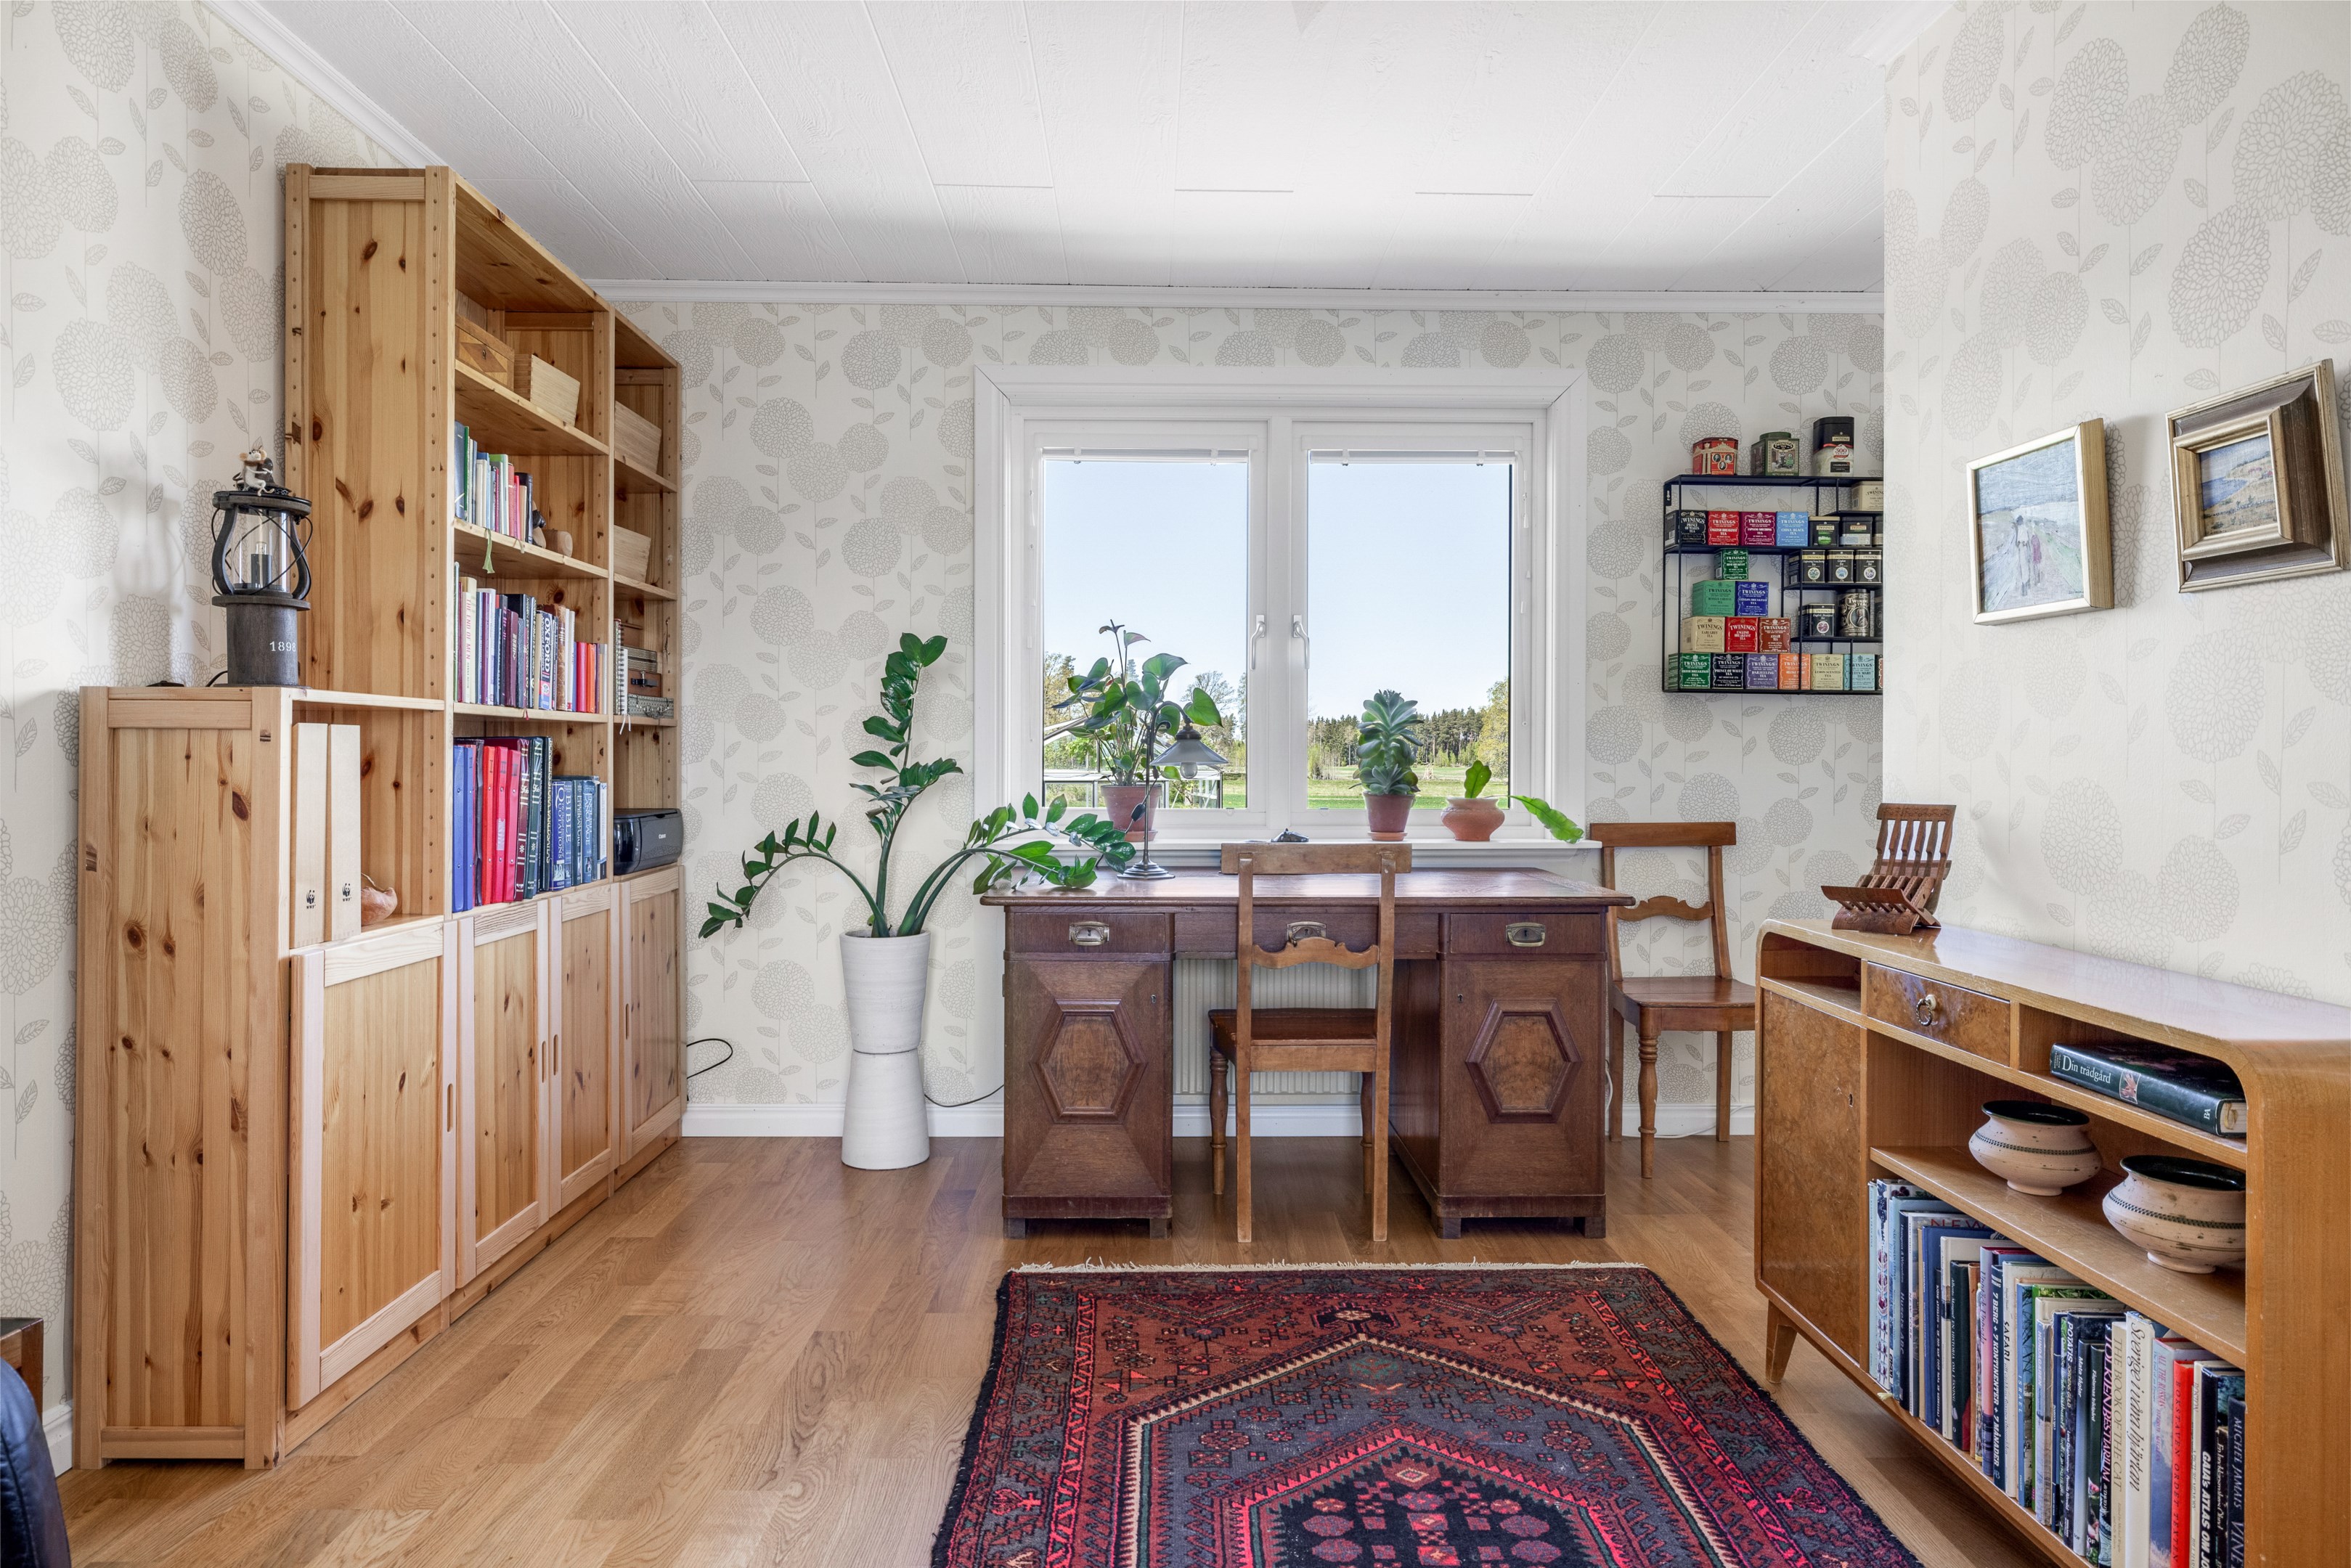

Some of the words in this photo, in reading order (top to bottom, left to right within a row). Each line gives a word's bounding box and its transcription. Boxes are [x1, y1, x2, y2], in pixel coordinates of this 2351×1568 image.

[269, 641, 296, 652] 1898
[465, 632, 471, 640] OF
[555, 787, 565, 859] QUOTATIONS
[2061, 1055, 2078, 1072] Din
[2080, 1065, 2111, 1085] trädgård
[2203, 1108, 2211, 1120] BA
[1951, 1320, 1955, 1329] EN
[1951, 1361, 1955, 1372] OM
[2127, 1323, 2146, 1379] Sverige
[2114, 1368, 2122, 1404] BOOK
[2130, 1381, 2143, 1390] i
[2114, 1405, 2122, 1424] OF
[2130, 1392, 2145, 1428] våra
[2233, 1416, 2243, 1463] MICHEL
[2113, 1457, 2122, 1492] CAT
[2127, 1429, 2146, 1493] hjärtan
[2201, 1451, 2211, 1487] GAIA's
[2231, 1464, 2243, 1510] JAMAIS
[2201, 1491, 2211, 1529] ATLAS
[2201, 1532, 2210, 1551] OM
